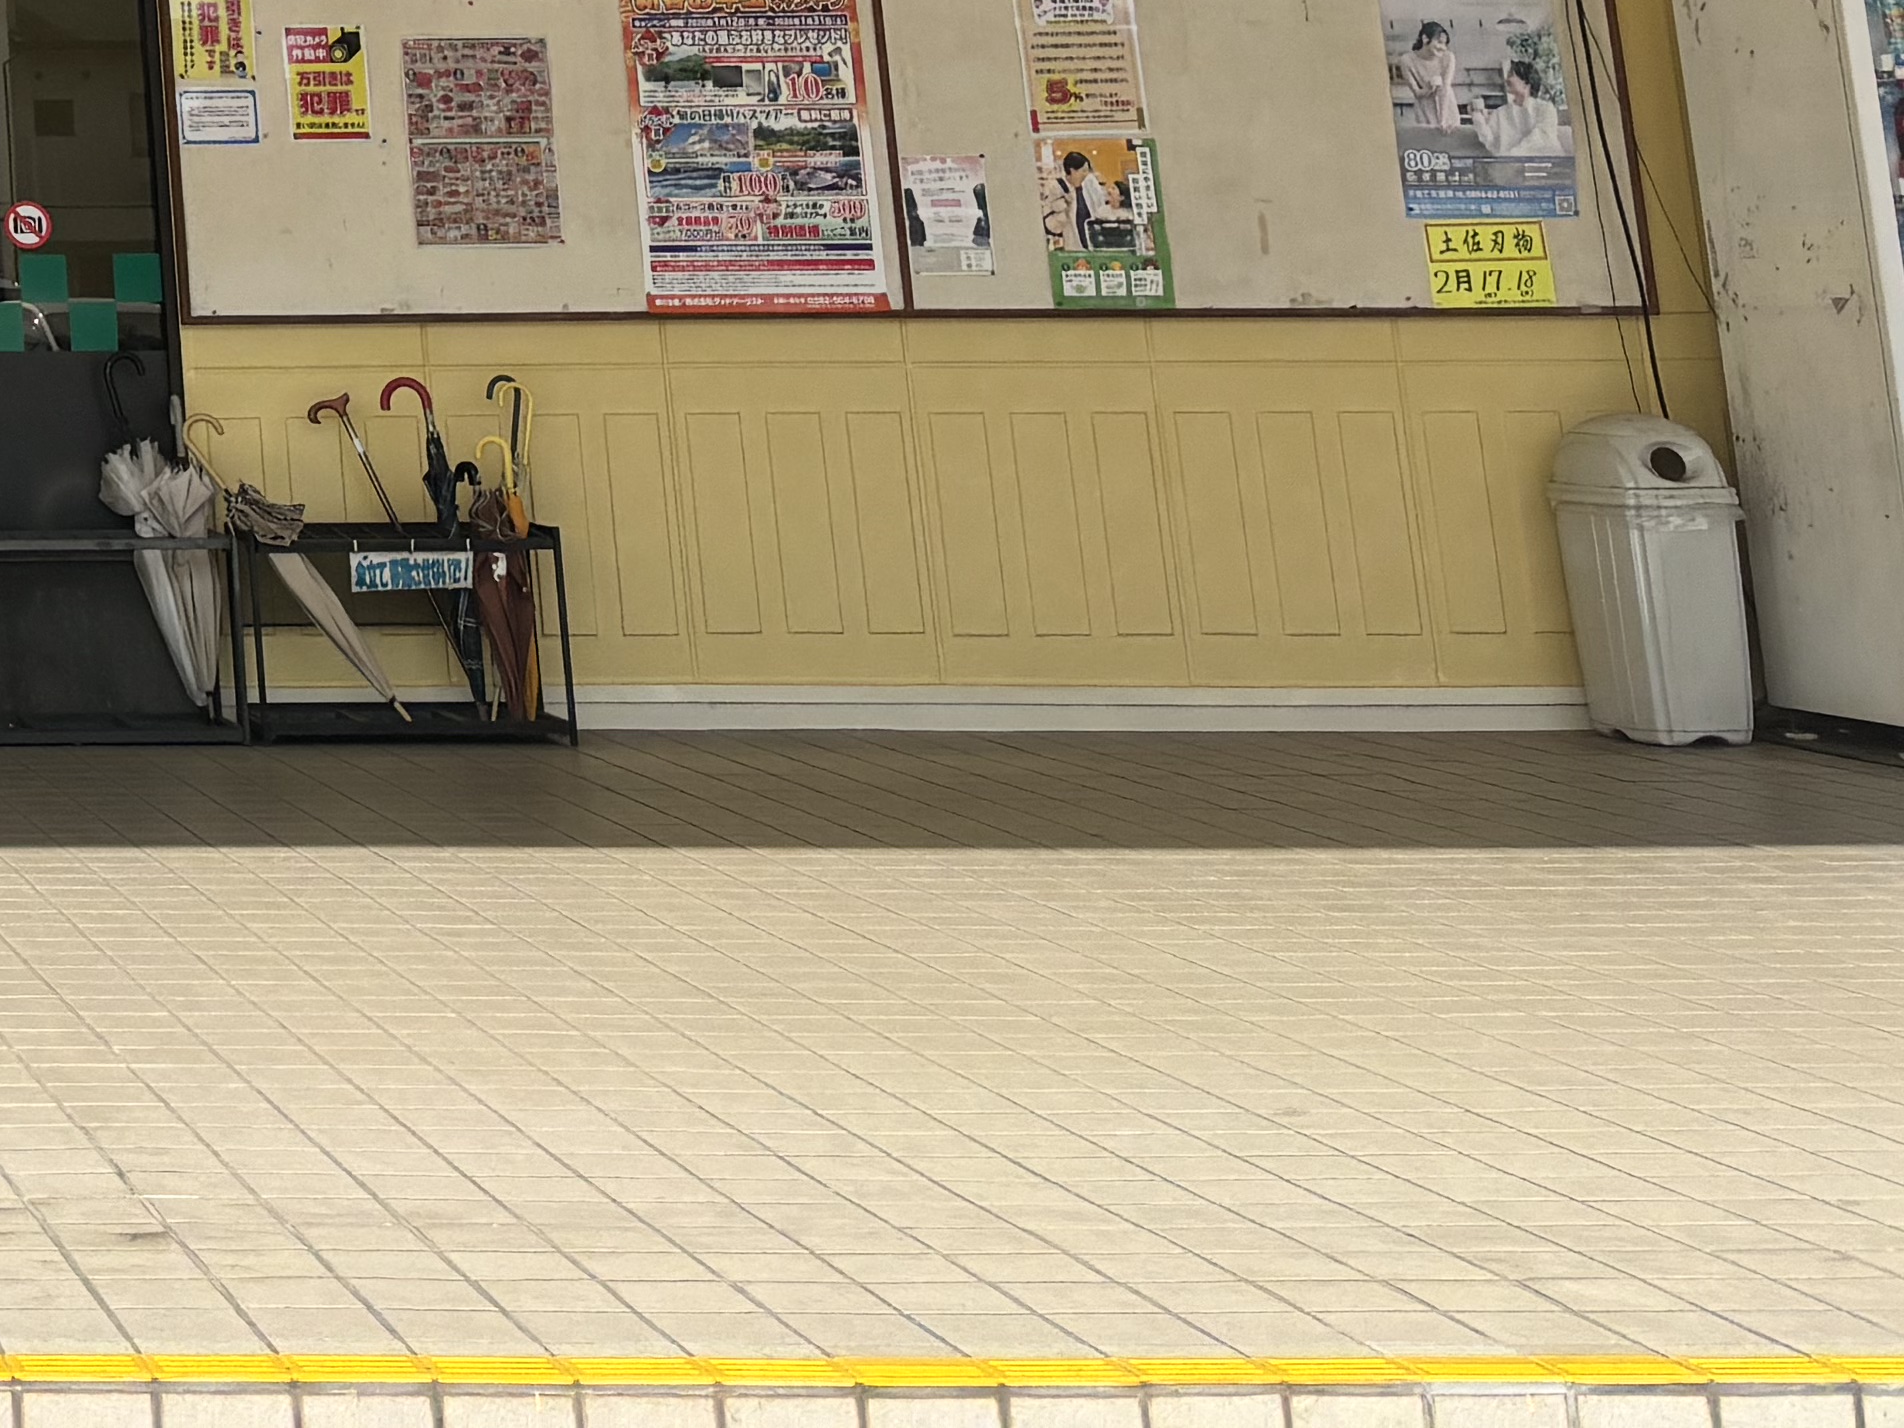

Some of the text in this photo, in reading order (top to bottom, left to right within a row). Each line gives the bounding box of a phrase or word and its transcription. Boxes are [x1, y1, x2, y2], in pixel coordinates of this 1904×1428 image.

[195, 0, 222, 71] 犯罪です
[295, 70, 354, 89] 万引きは
[298, 89, 366, 118] 犯罪です
[1438, 226, 1534, 255] 土佐刃物
